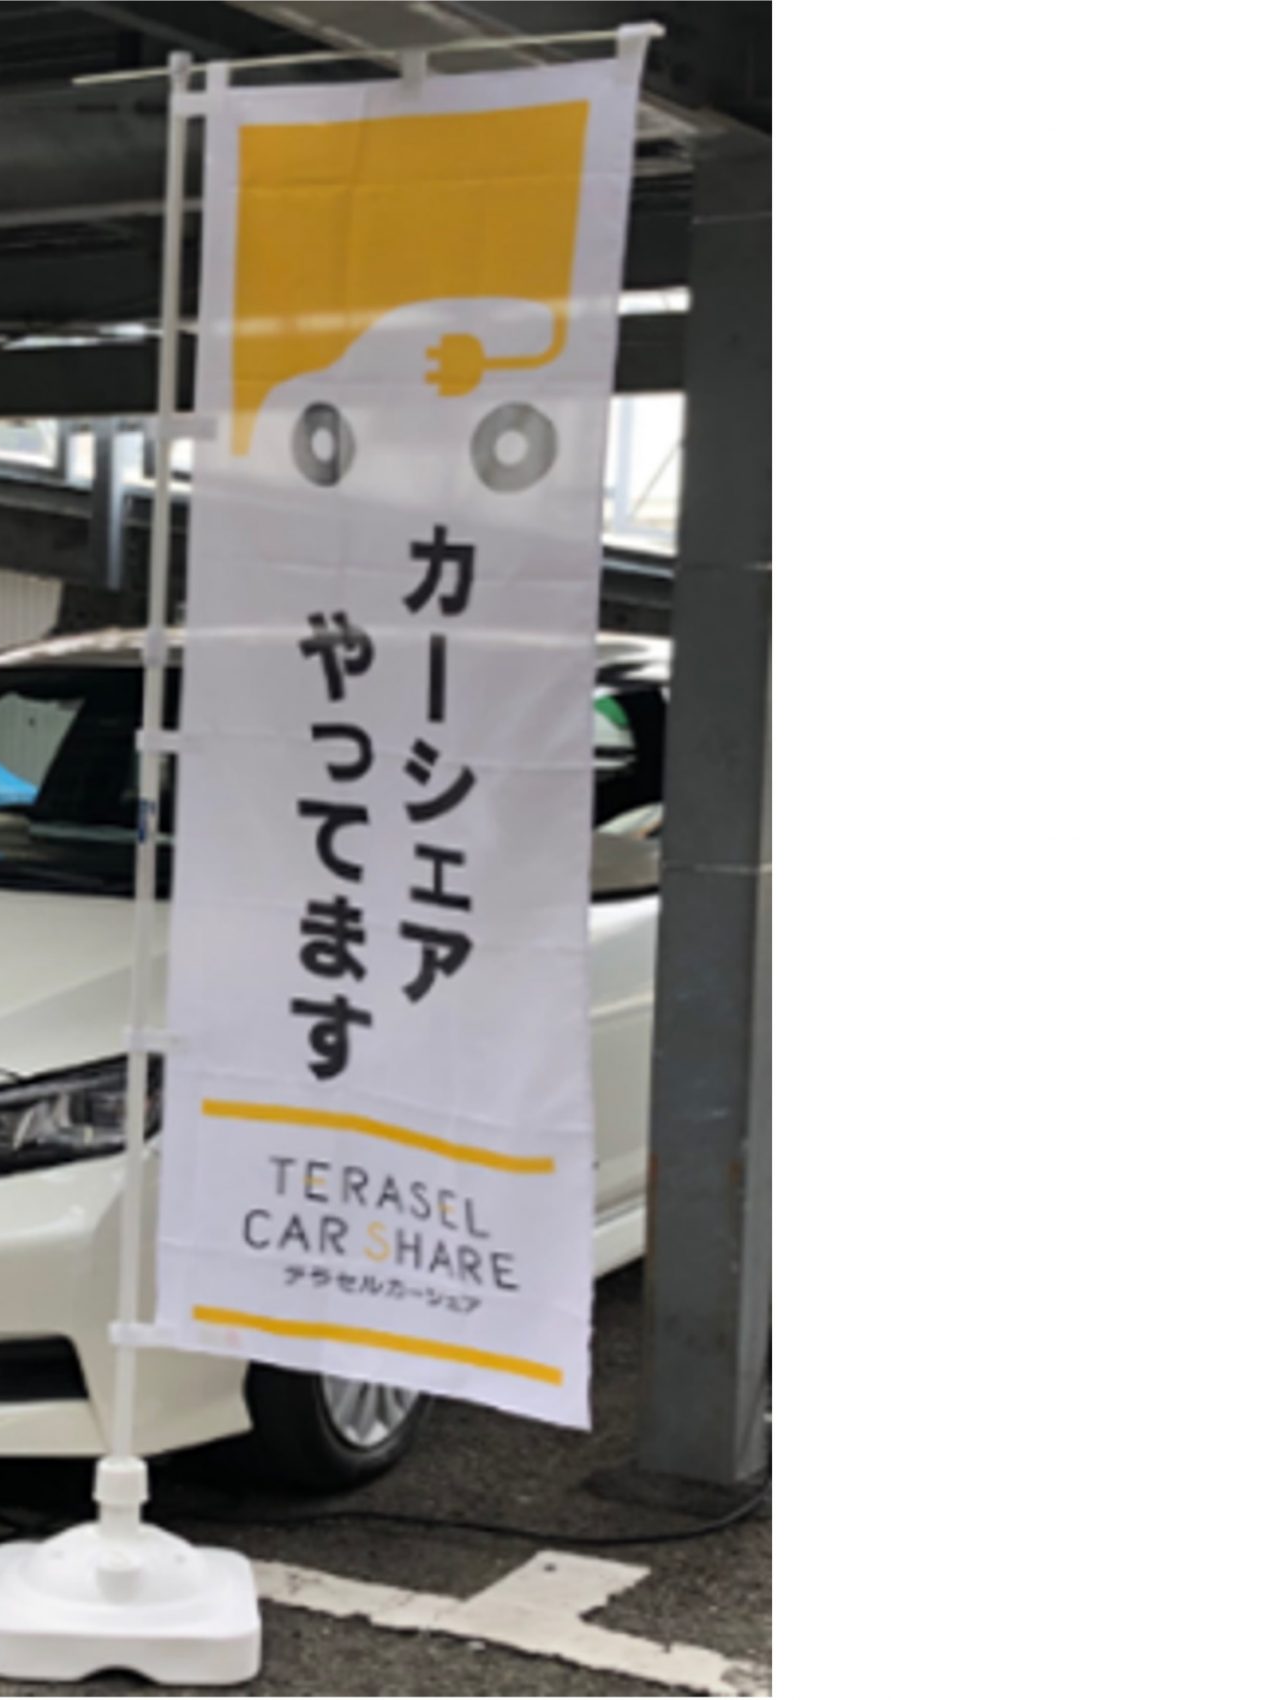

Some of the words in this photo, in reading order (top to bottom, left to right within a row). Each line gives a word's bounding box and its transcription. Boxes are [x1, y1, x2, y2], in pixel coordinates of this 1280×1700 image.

[290, 611, 374, 1081] やってます
[399, 524, 476, 1003] カーシェア
[243, 1209, 349, 1256] CAR
[363, 1221, 520, 1291] SHARE
[269, 1156, 490, 1240] TERASEL
